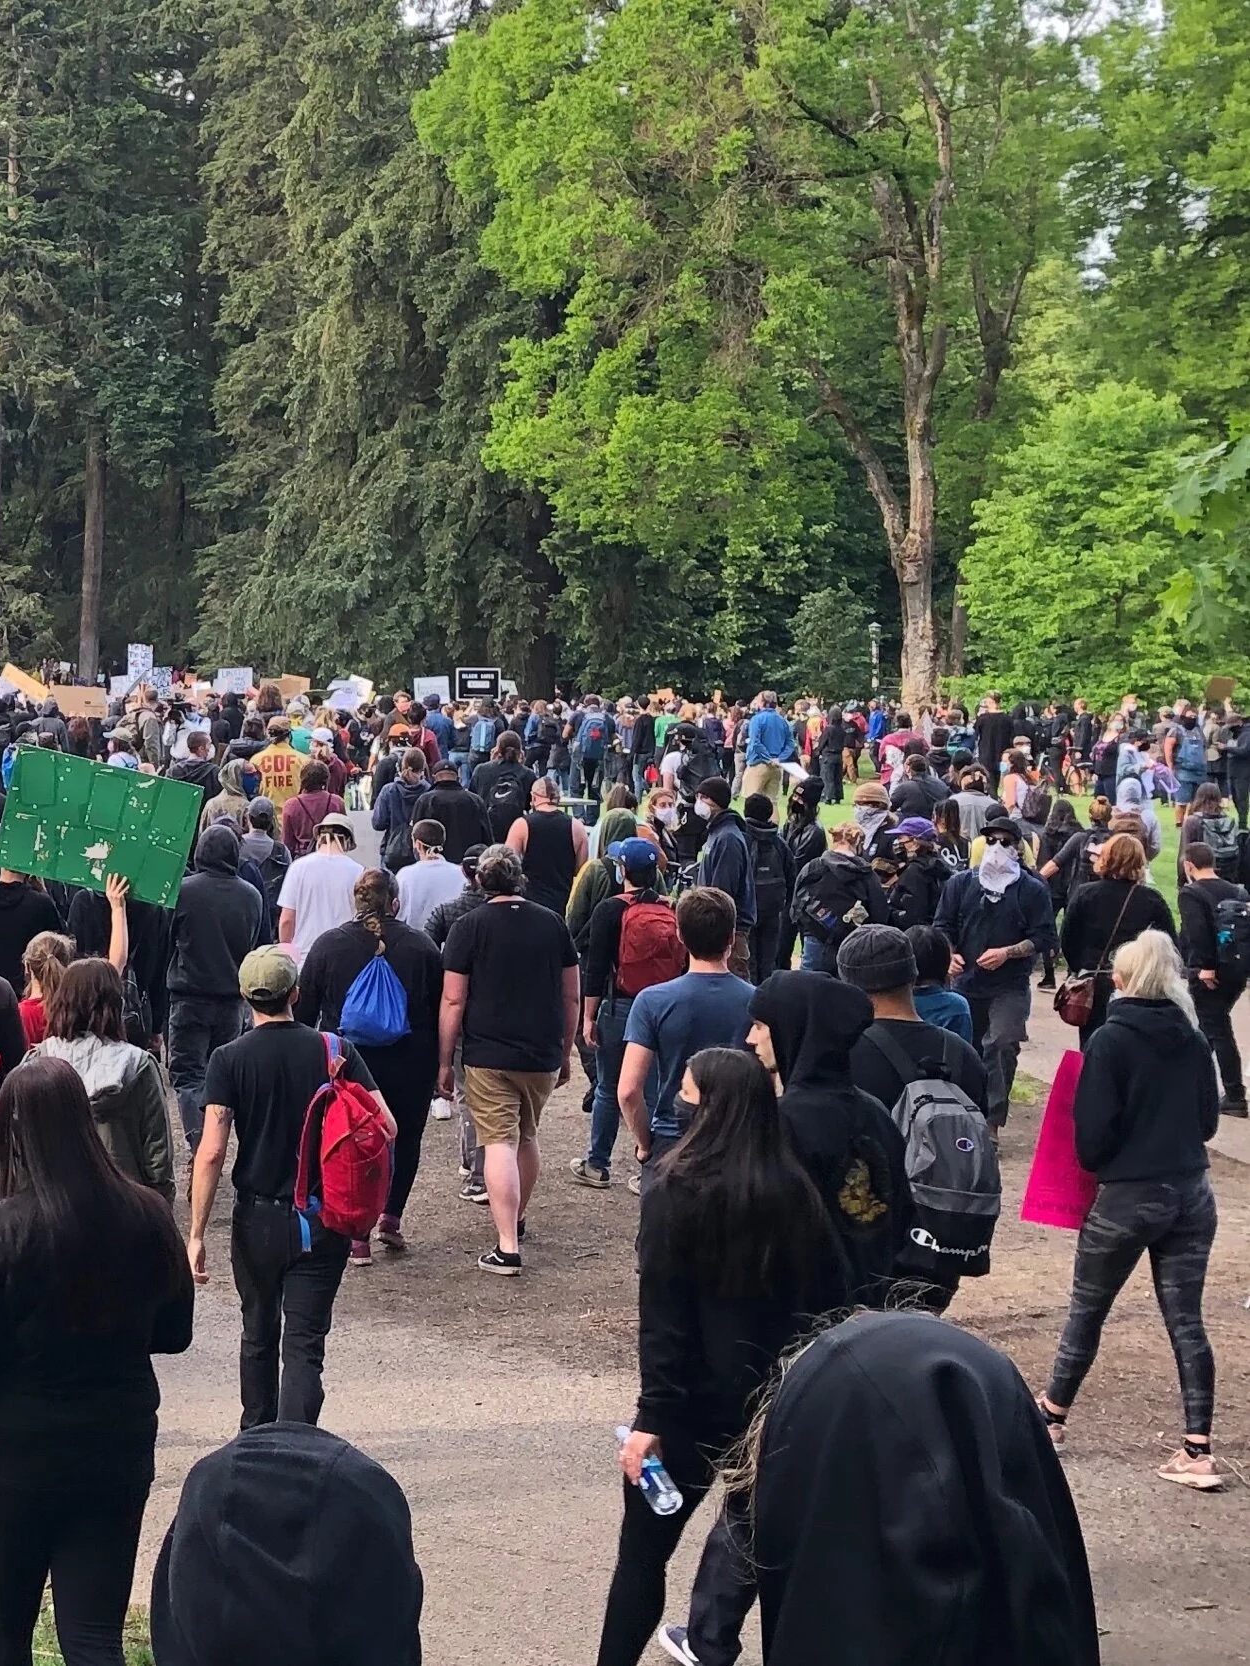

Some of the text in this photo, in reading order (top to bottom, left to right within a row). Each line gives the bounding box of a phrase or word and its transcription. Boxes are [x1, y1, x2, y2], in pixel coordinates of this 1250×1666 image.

[260, 755, 297, 773] CDF
[265, 775, 293, 788] FIRE
[940, 842, 970, 867] BL
[910, 1227, 988, 1262] Champn
